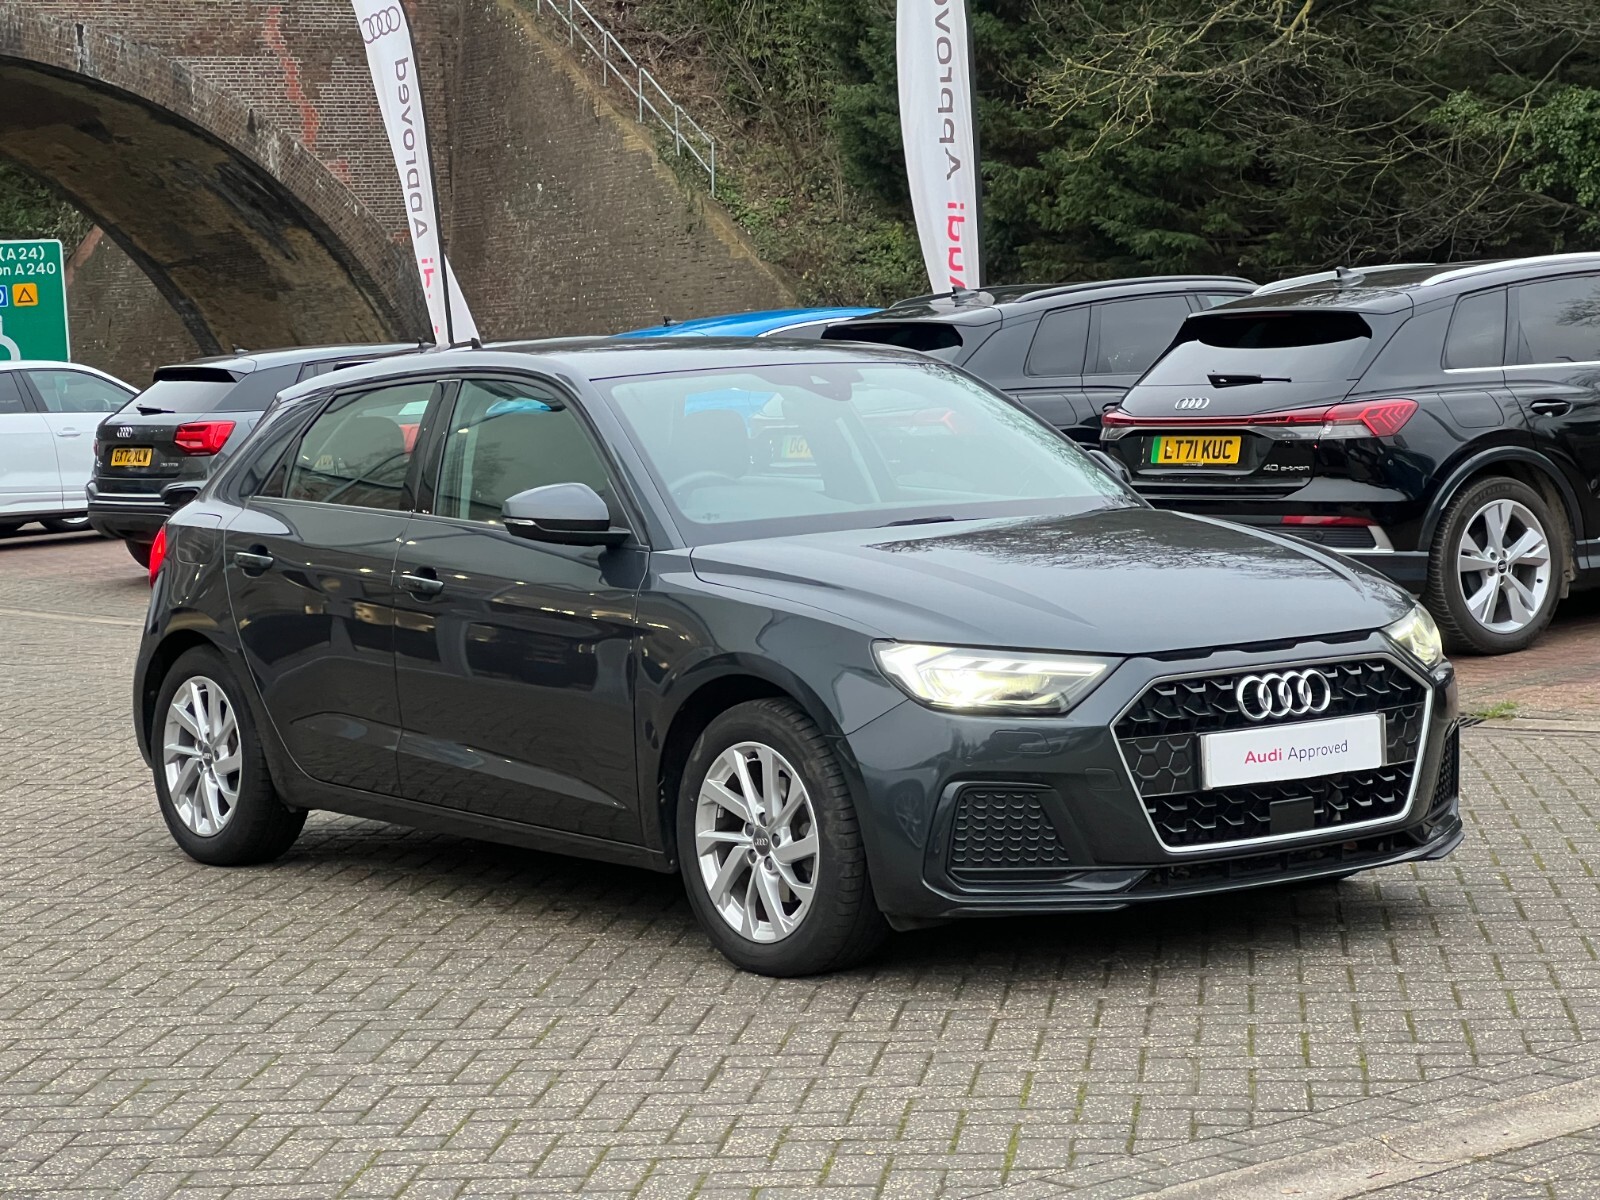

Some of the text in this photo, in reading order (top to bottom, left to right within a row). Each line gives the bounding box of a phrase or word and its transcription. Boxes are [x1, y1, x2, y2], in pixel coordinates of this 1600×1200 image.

[14, 262, 56, 276] A240
[114, 449, 150, 463] GX72 XLW
[1163, 439, 1234, 460] LT71 KUC
[1280, 464, 1310, 472] e-tron
[1244, 739, 1348, 764] Audi Approved
